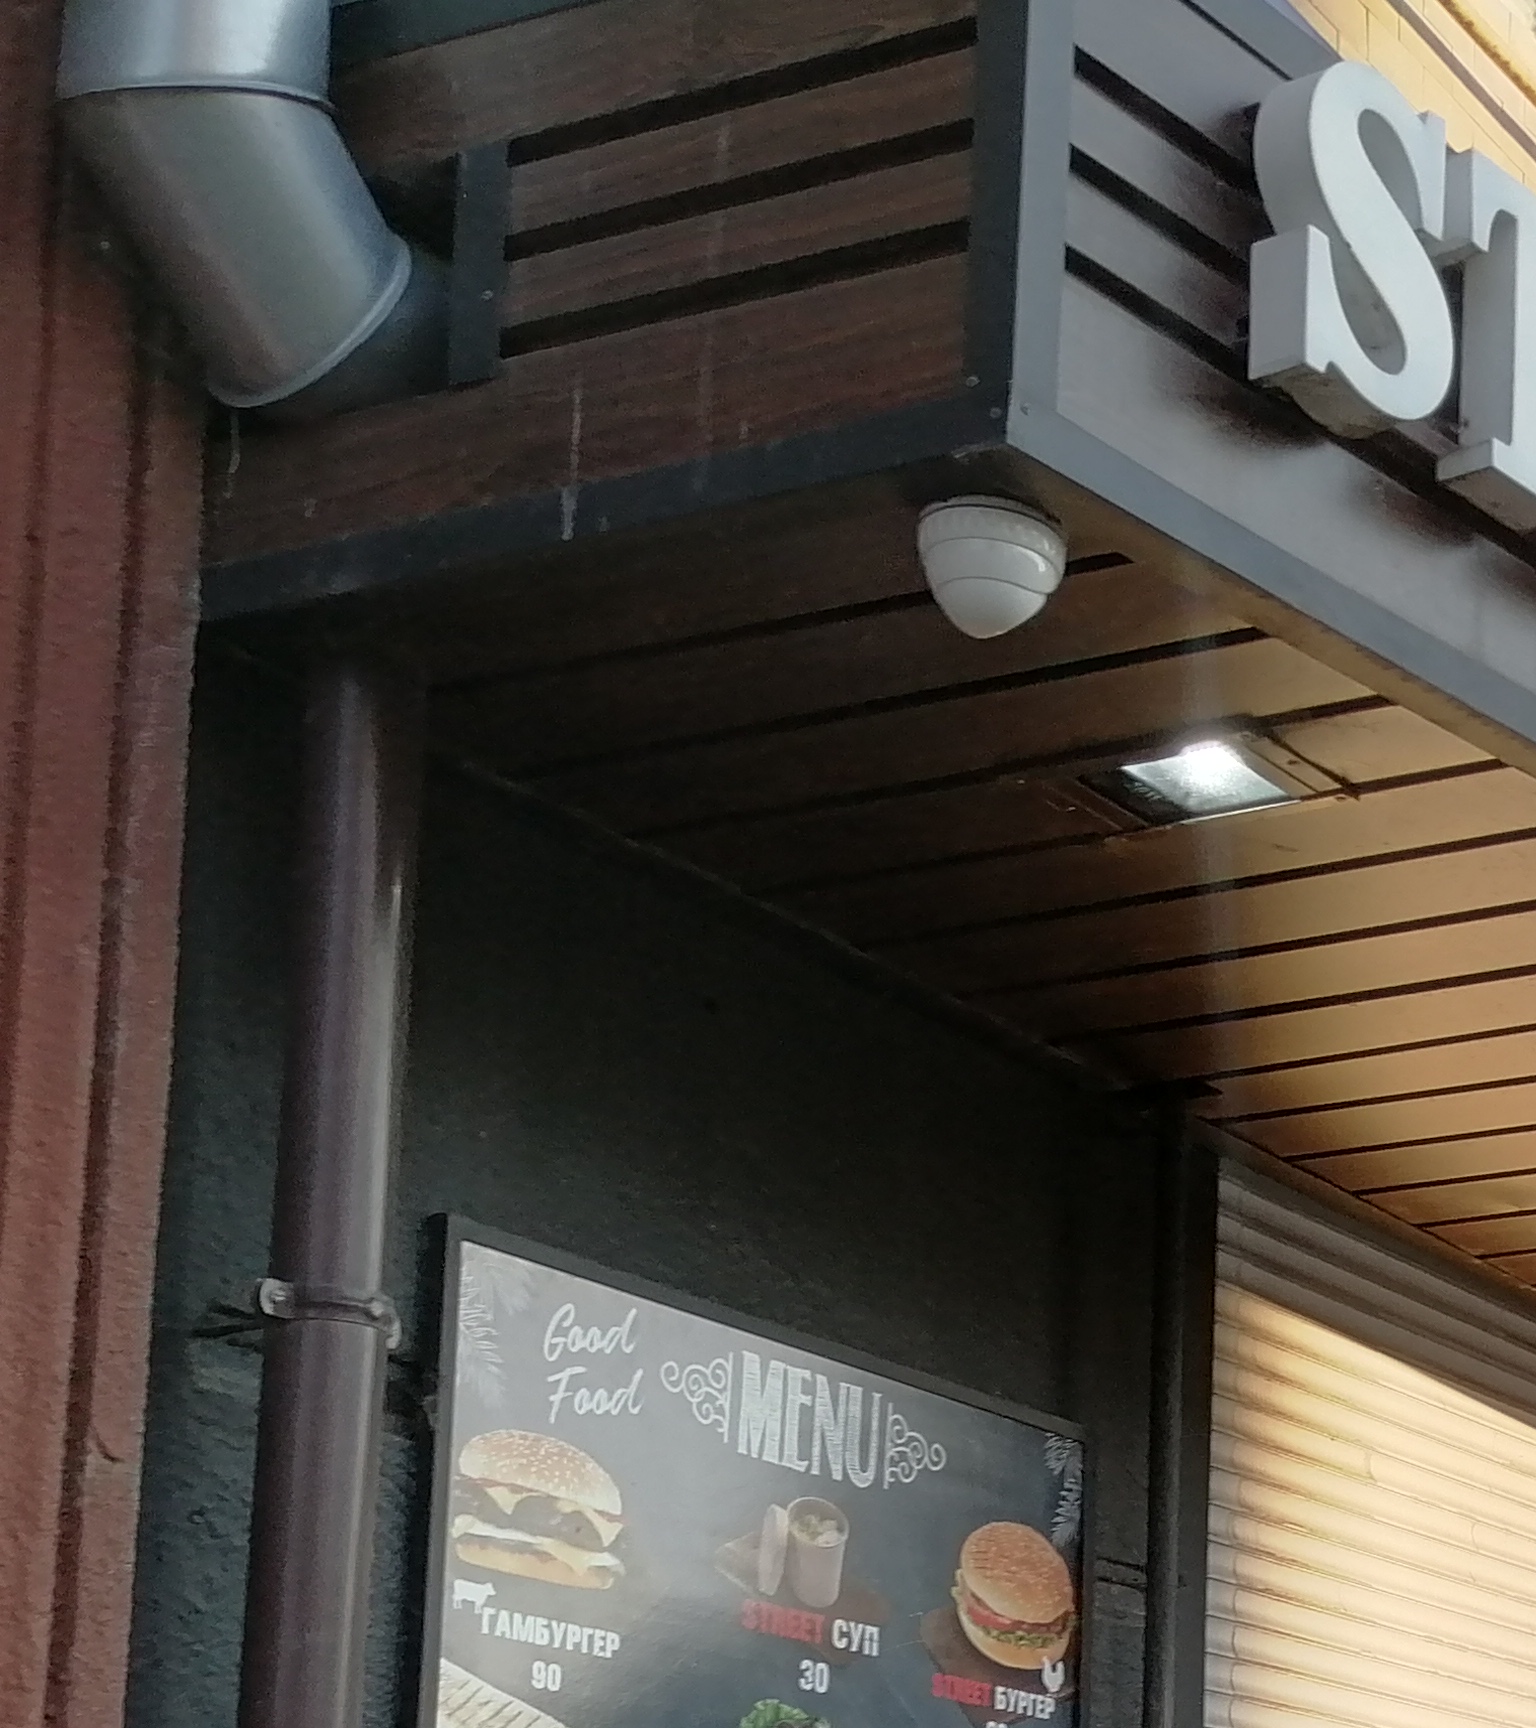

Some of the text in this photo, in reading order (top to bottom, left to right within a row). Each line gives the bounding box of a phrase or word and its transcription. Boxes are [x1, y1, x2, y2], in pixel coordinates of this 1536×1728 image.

[543, 1302, 638, 1362] Good
[547, 1366, 644, 1424] Food
[736, 1350, 884, 1489] MENU
[480, 1606, 621, 1660] ГАМБУРГЕР
[830, 1618, 881, 1657] СУП
[531, 1660, 563, 1692] 90
[798, 1658, 831, 1694] 30
[993, 1685, 1057, 1720] БУРГЕР
